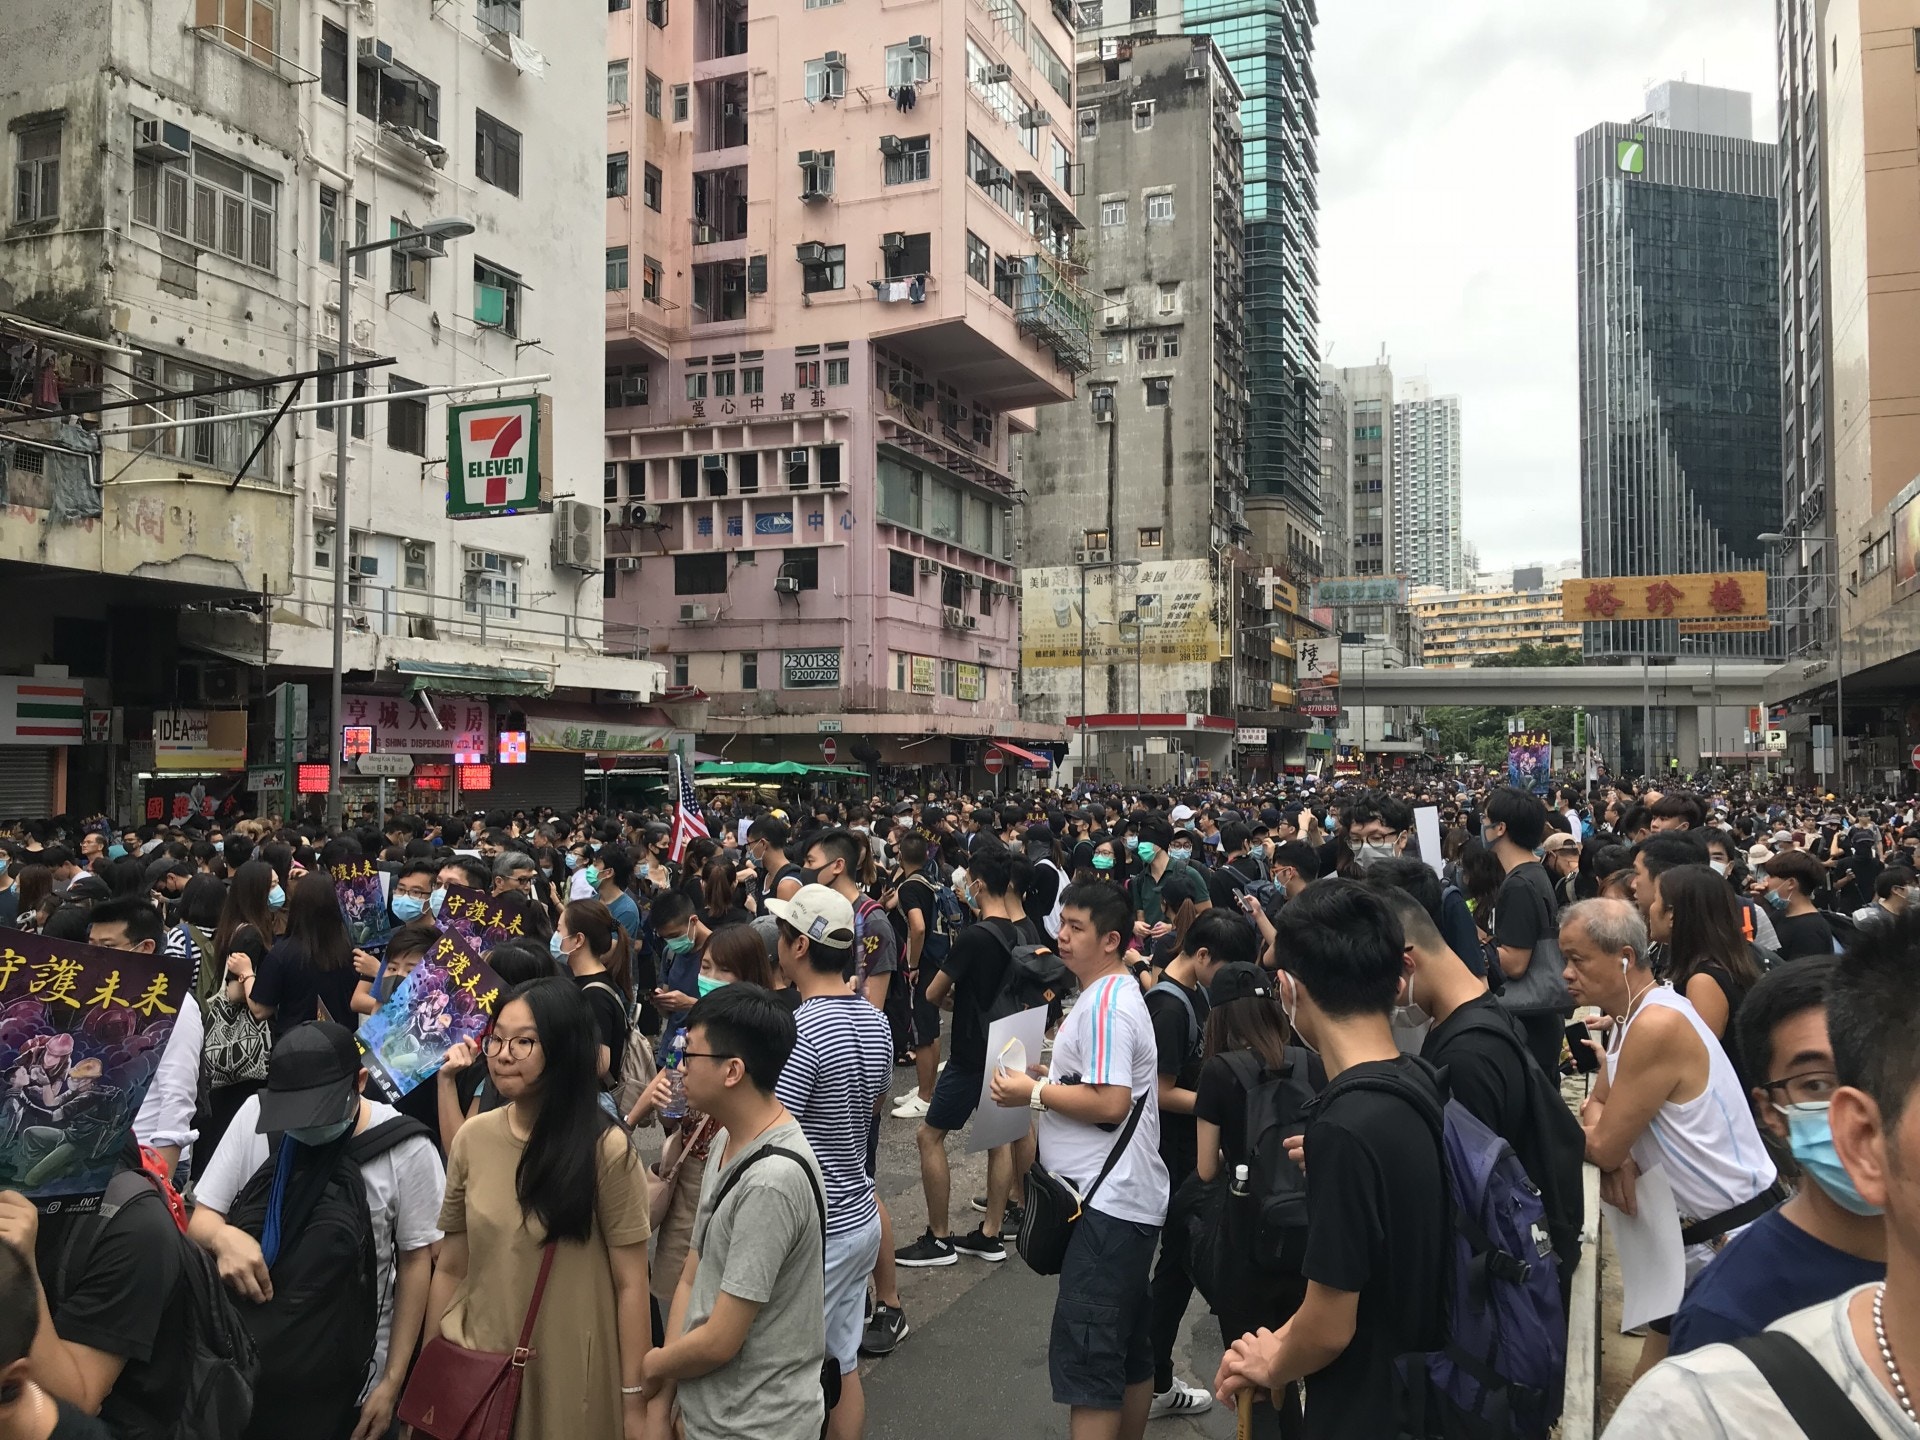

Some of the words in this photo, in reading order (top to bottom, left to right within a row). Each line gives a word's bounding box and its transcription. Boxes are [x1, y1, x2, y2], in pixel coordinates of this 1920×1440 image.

[470, 414, 522, 459] 7
[784, 653, 839, 668] 23001388
[791, 668, 838, 680] 92007207
[159, 718, 190, 741] IDEA
